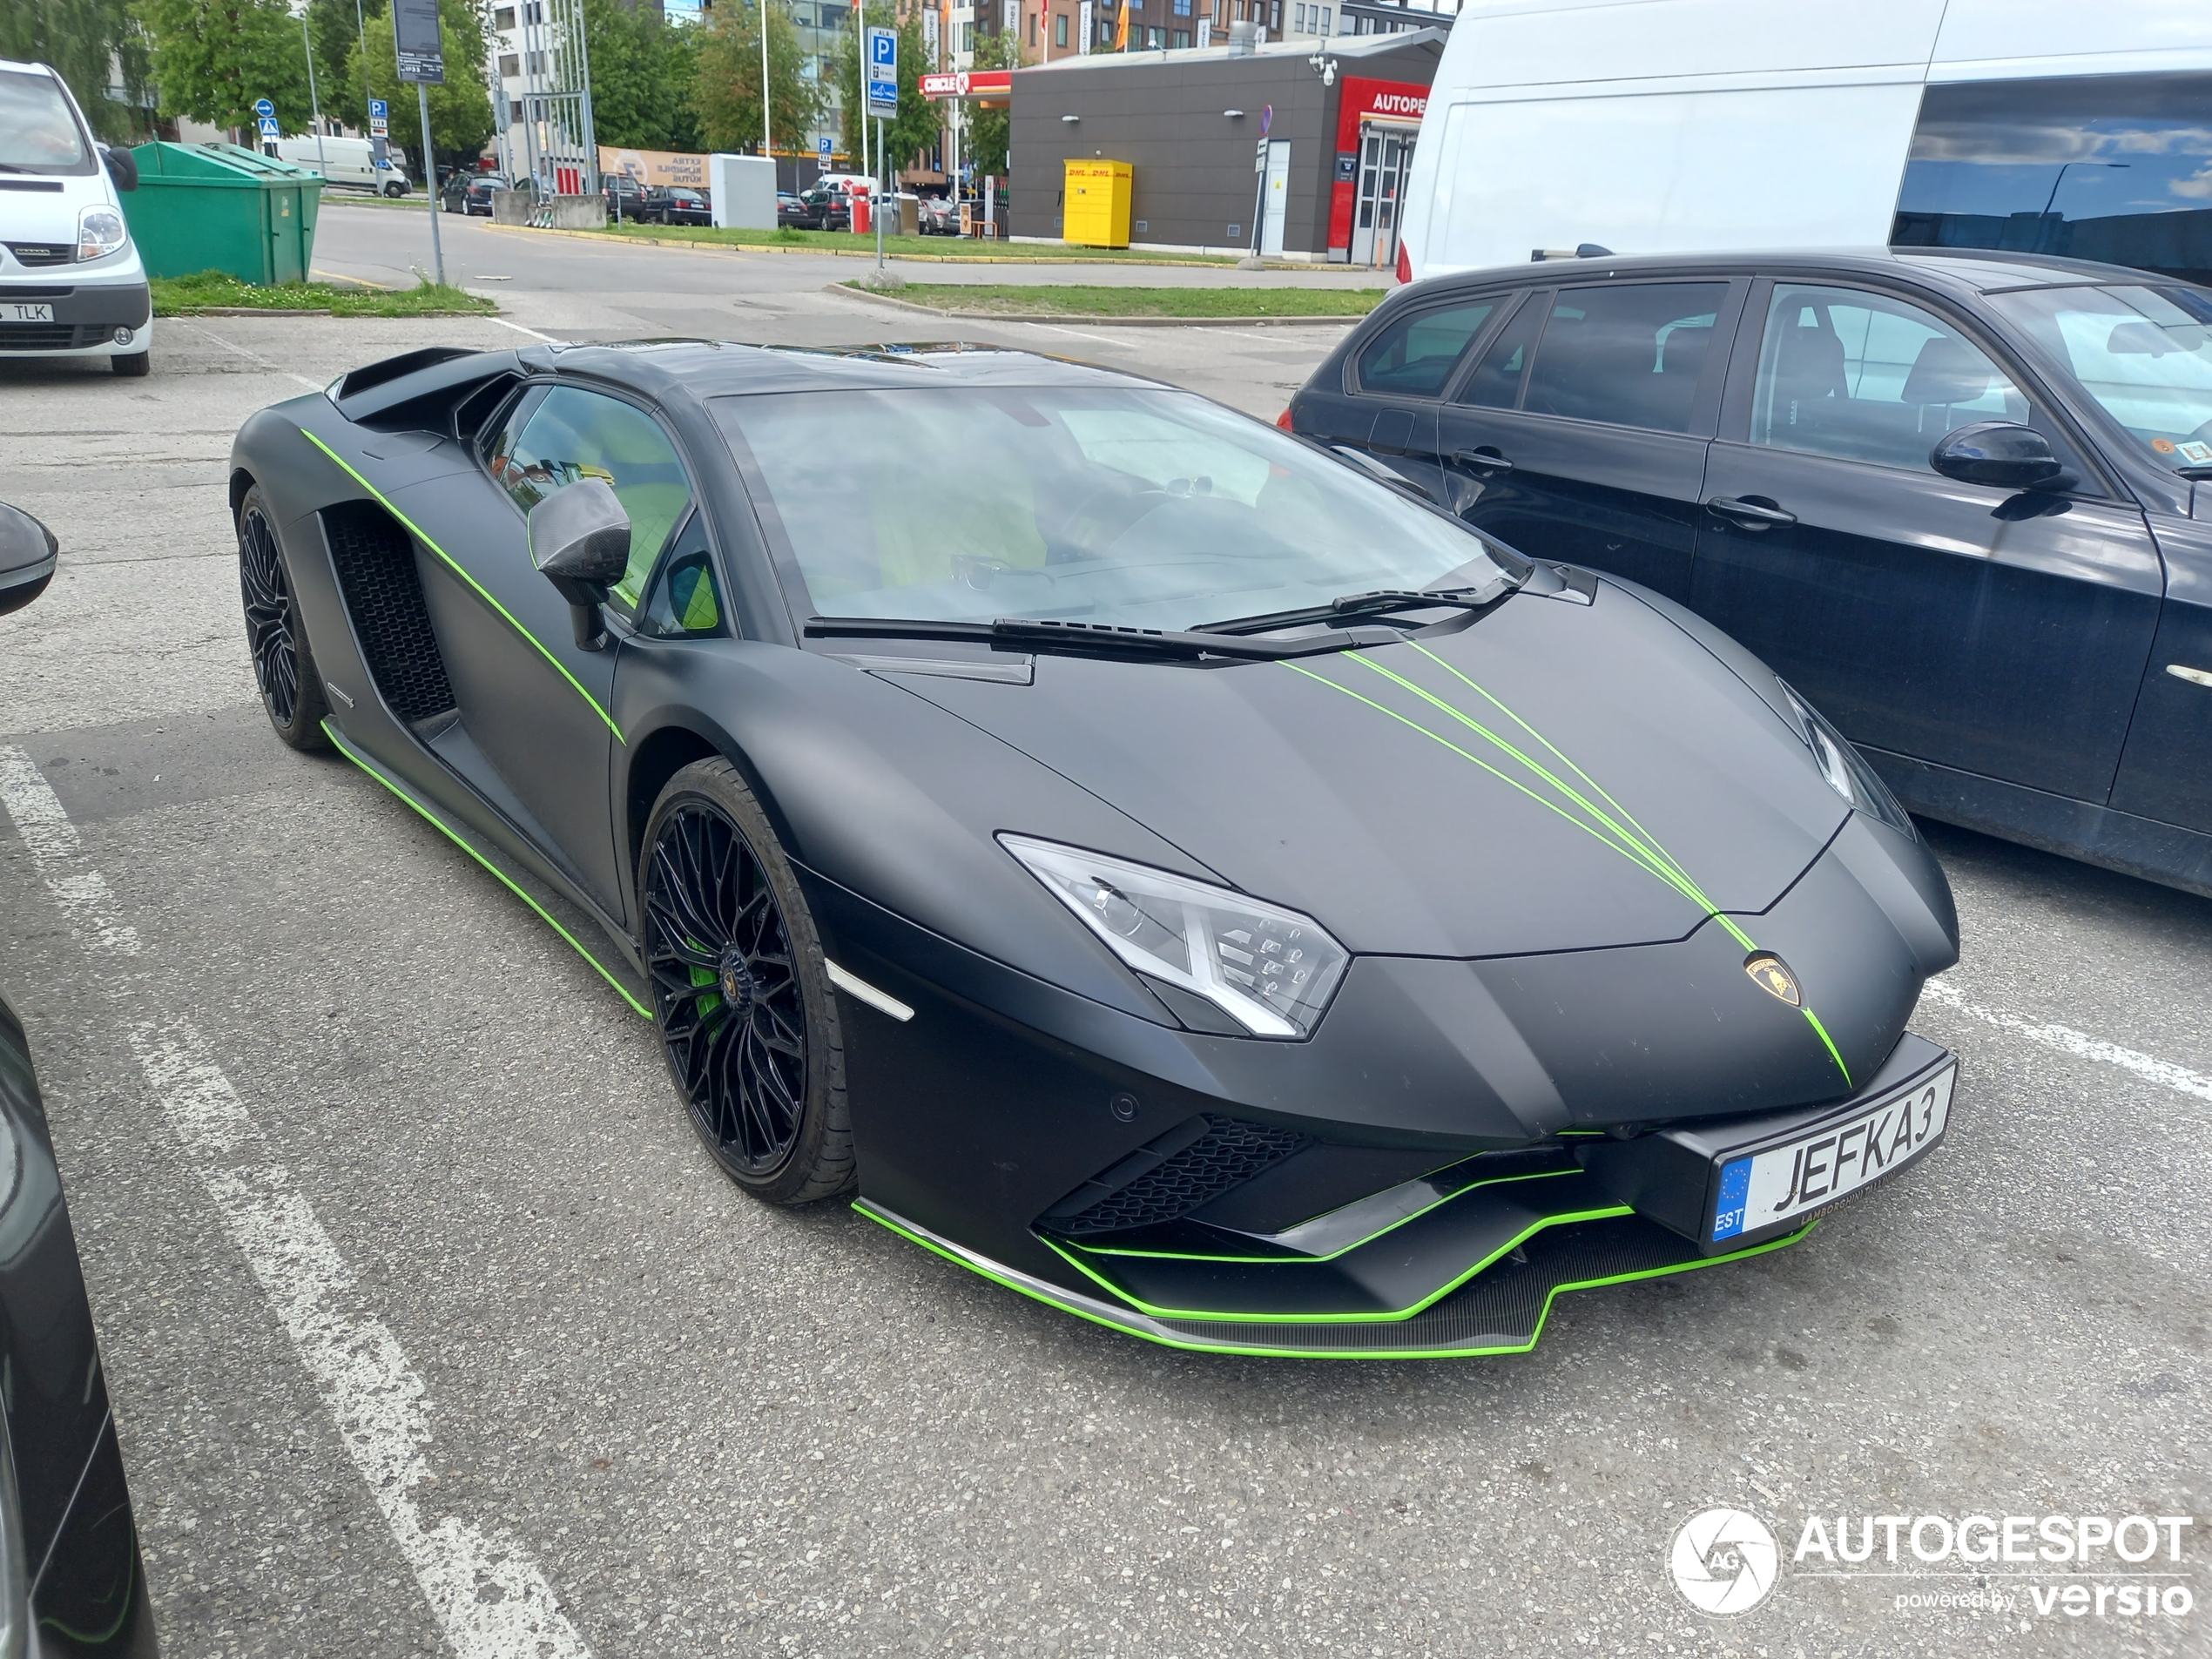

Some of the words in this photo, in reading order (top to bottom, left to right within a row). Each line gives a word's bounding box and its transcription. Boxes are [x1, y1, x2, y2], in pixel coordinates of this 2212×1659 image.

[878, 38, 889, 61] P
[924, 77, 956, 92] CIRCLE
[959, 77, 968, 91] K
[372, 102, 381, 115] P
[821, 139, 828, 152] P
[14, 306, 47, 320] TLK
[1773, 1086, 1936, 1212] JEFKA3
[1800, 1190, 1864, 1225] LAMBORGHINI
[1865, 1171, 1896, 1196] TALLINN
[1715, 1208, 1743, 1232] EST
